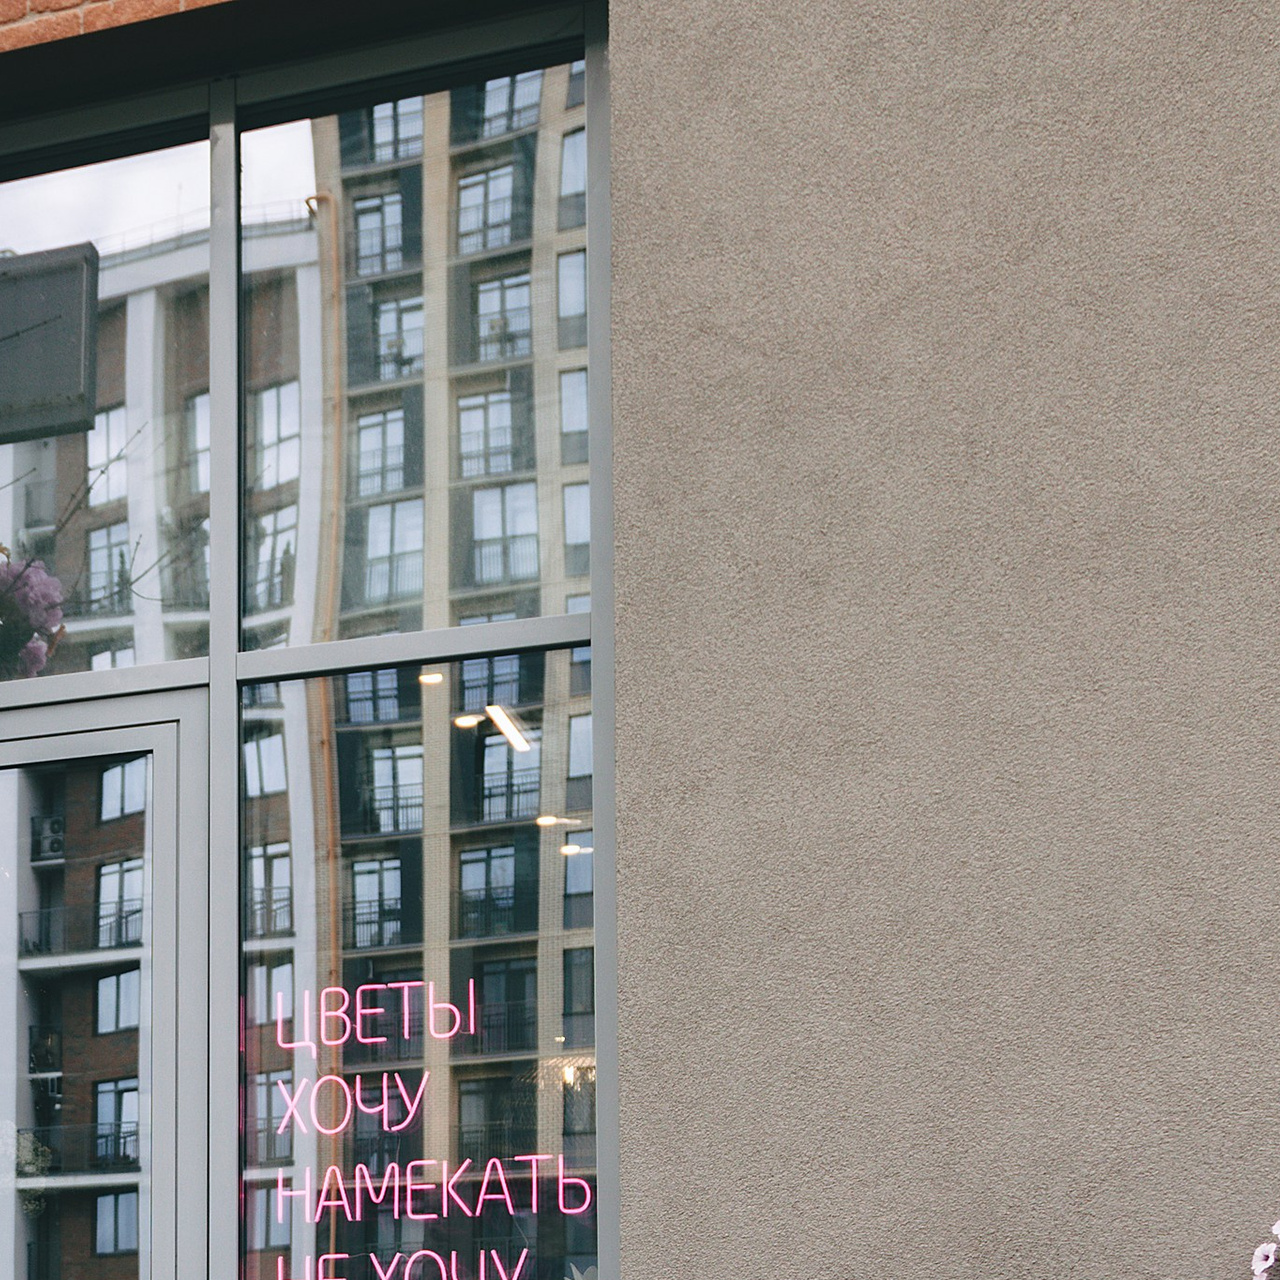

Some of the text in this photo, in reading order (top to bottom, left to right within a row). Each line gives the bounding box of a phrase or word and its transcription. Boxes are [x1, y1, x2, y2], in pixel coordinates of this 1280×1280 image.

[276, 977, 476, 1060] ЦВЕТЫ
[276, 1070, 431, 1136] ХОЧУ
[277, 1153, 593, 1224] НАМЕКАТЬ
